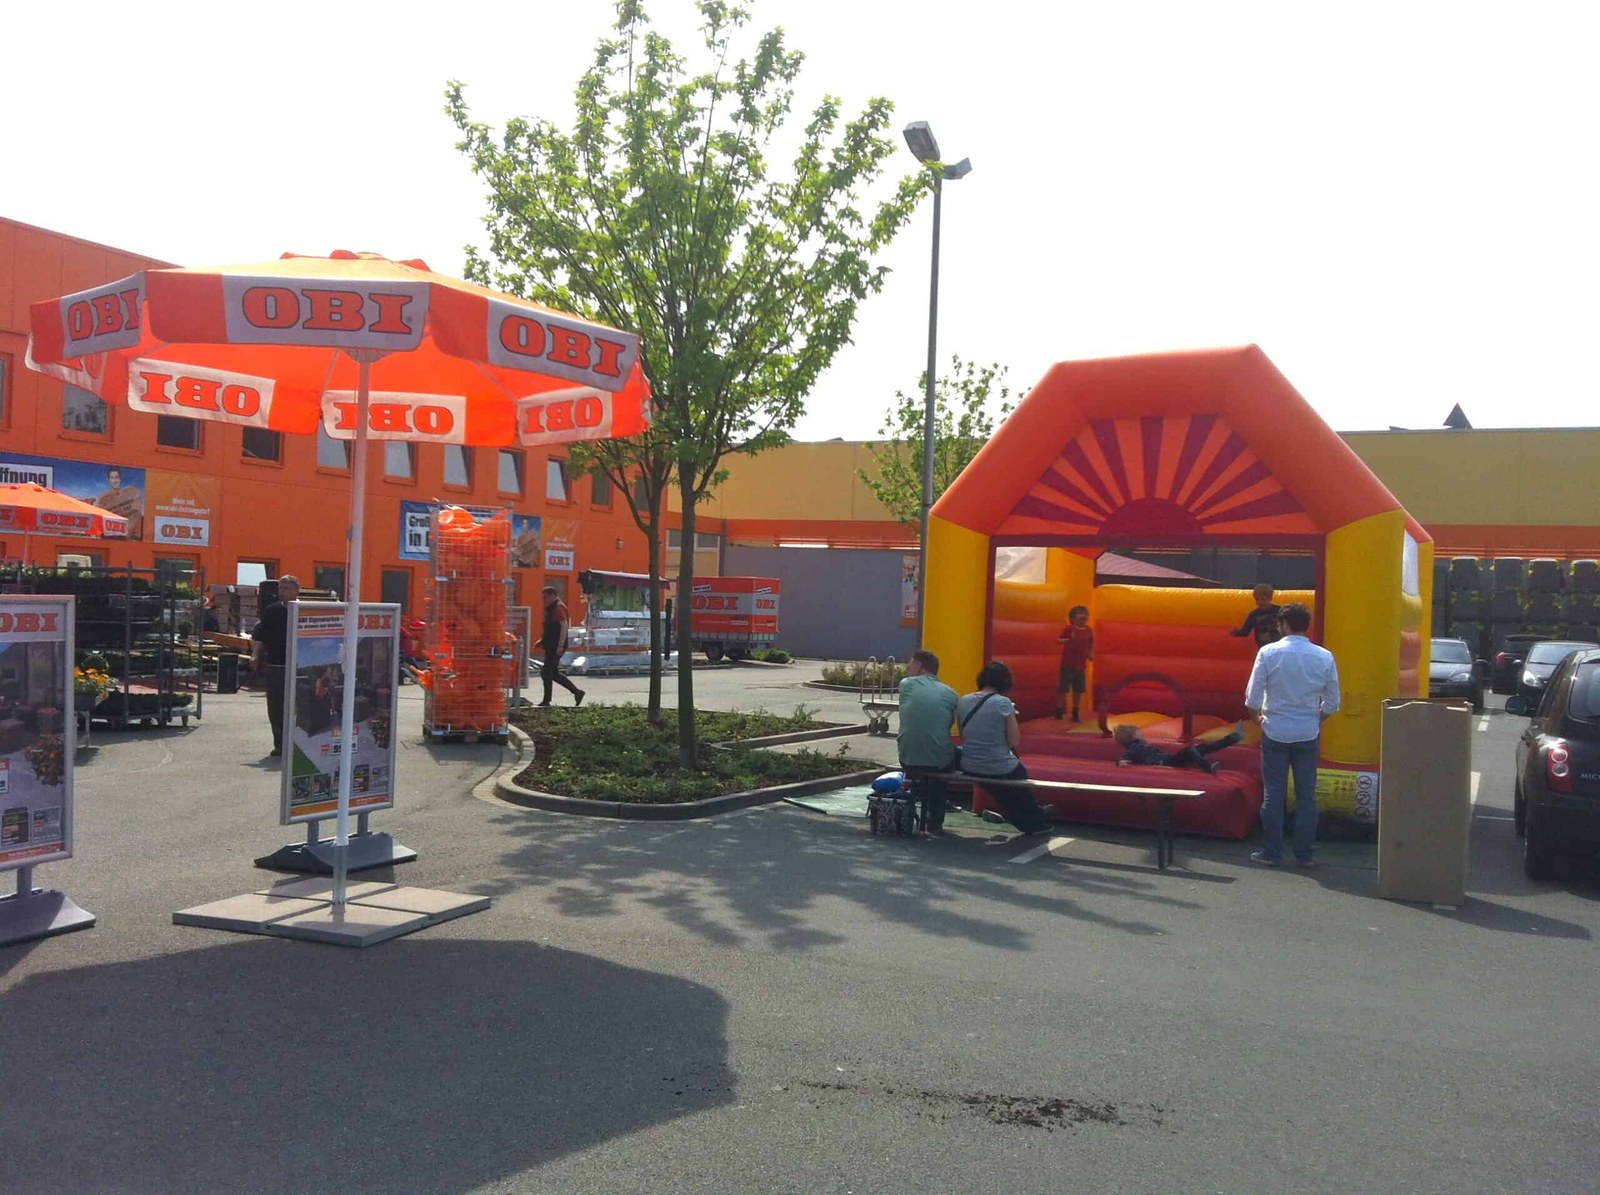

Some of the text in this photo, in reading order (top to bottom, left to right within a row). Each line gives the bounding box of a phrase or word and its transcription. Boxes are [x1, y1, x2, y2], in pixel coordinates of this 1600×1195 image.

[68, 288, 139, 341] OBI
[242, 286, 413, 335] OBI
[500, 314, 625, 378] OBI
[41, 512, 89, 528] OBI
[105, 519, 127, 533] OBI
[161, 524, 203, 539] OBI
[409, 529, 421, 547] in
[691, 596, 738, 610] OBI
[756, 599, 776, 609] OBI
